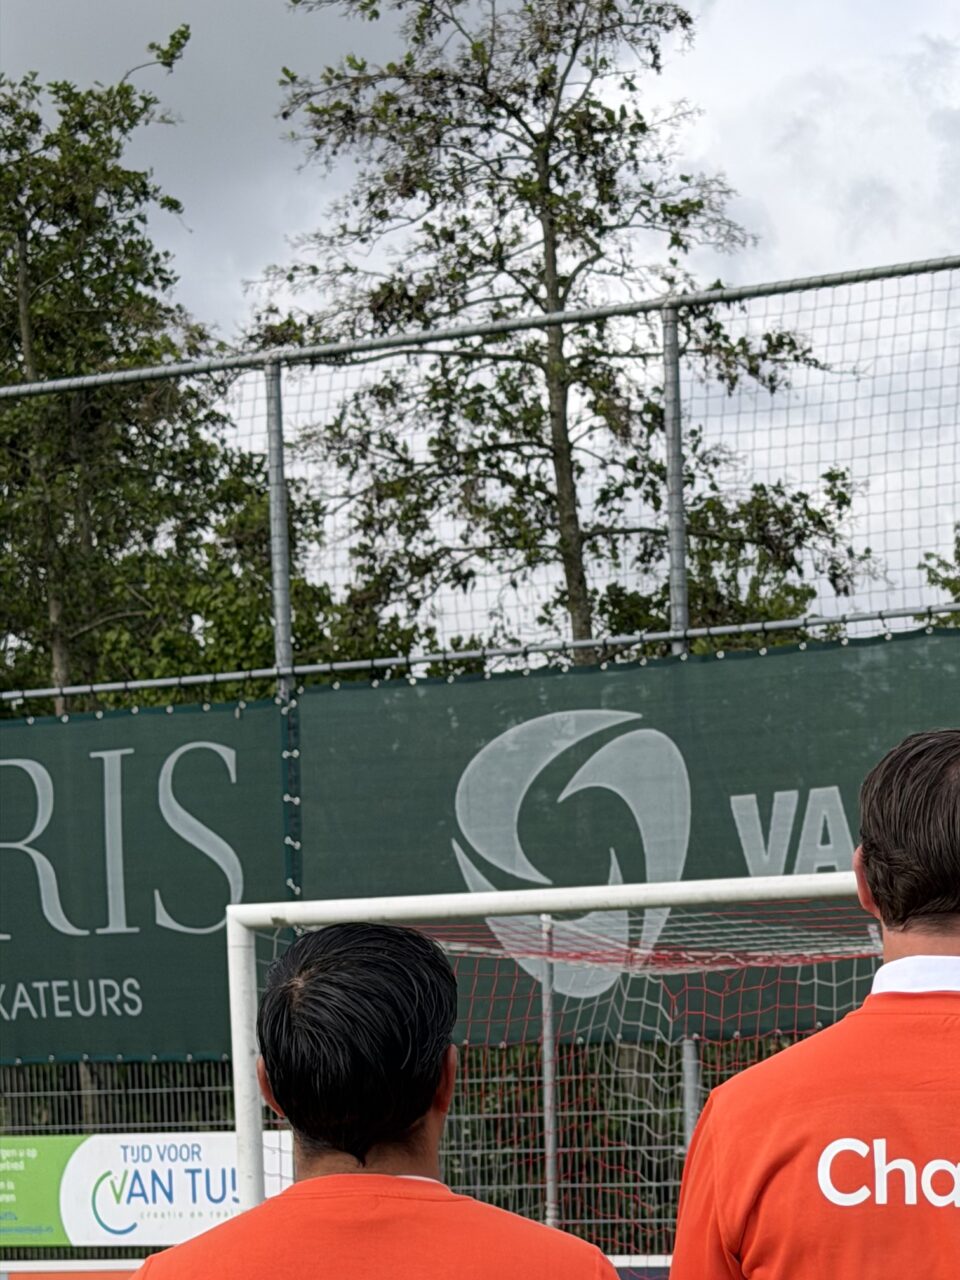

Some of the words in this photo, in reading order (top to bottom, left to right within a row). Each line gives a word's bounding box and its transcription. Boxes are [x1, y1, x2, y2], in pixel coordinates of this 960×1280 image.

[730, 786, 855, 877] VA
[156, 1143, 202, 1162] VOOR
[109, 1168, 174, 1205] VAN
